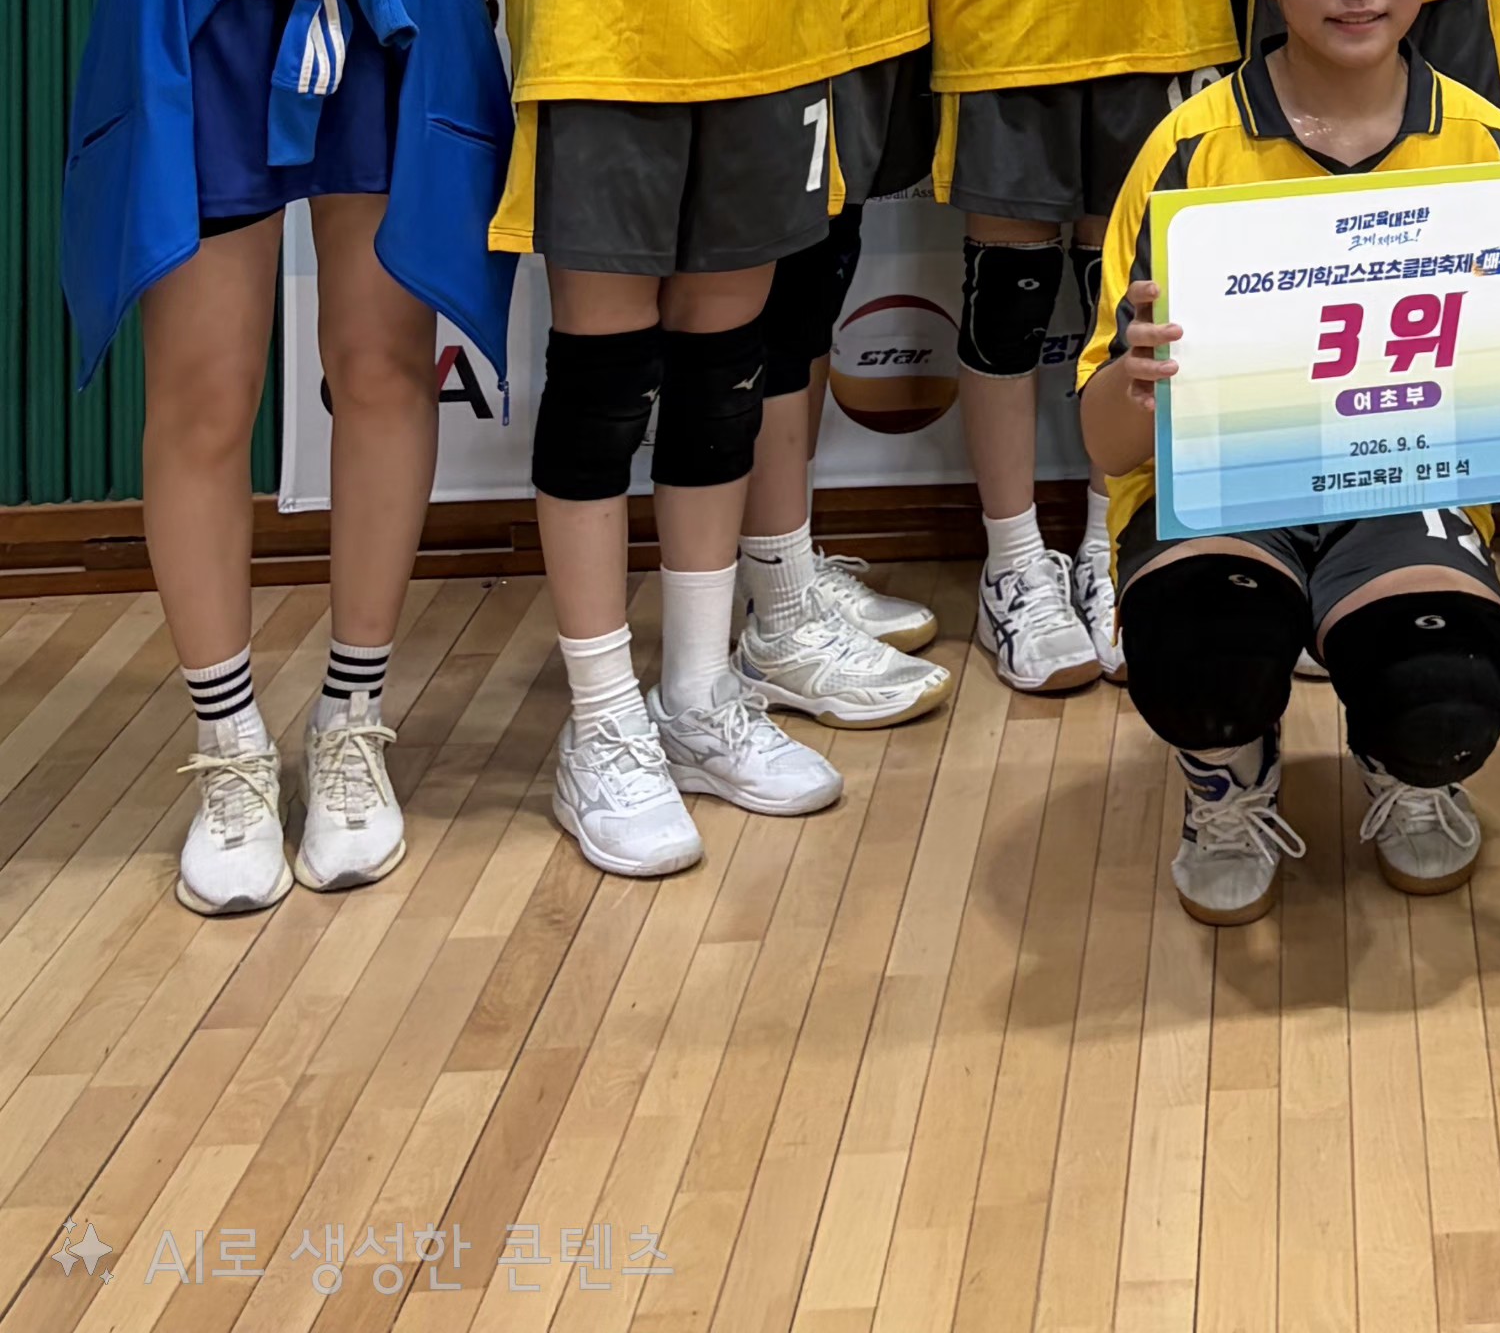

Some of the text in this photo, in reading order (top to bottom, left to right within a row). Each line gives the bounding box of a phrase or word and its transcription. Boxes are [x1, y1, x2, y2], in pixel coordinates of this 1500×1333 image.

[1335, 206, 1430, 234] 경기교육대전환
[1348, 229, 1422, 251] 크게 제대로!
[1224, 272, 1274, 297] 2026
[1276, 254, 1473, 291] 경기학교스포츠클럽축제
[1310, 290, 1469, 380] 3 위
[857, 348, 932, 366] star
[1350, 435, 1431, 457] 2026. 9. 6.
[1311, 467, 1403, 493] 경기도교육감
